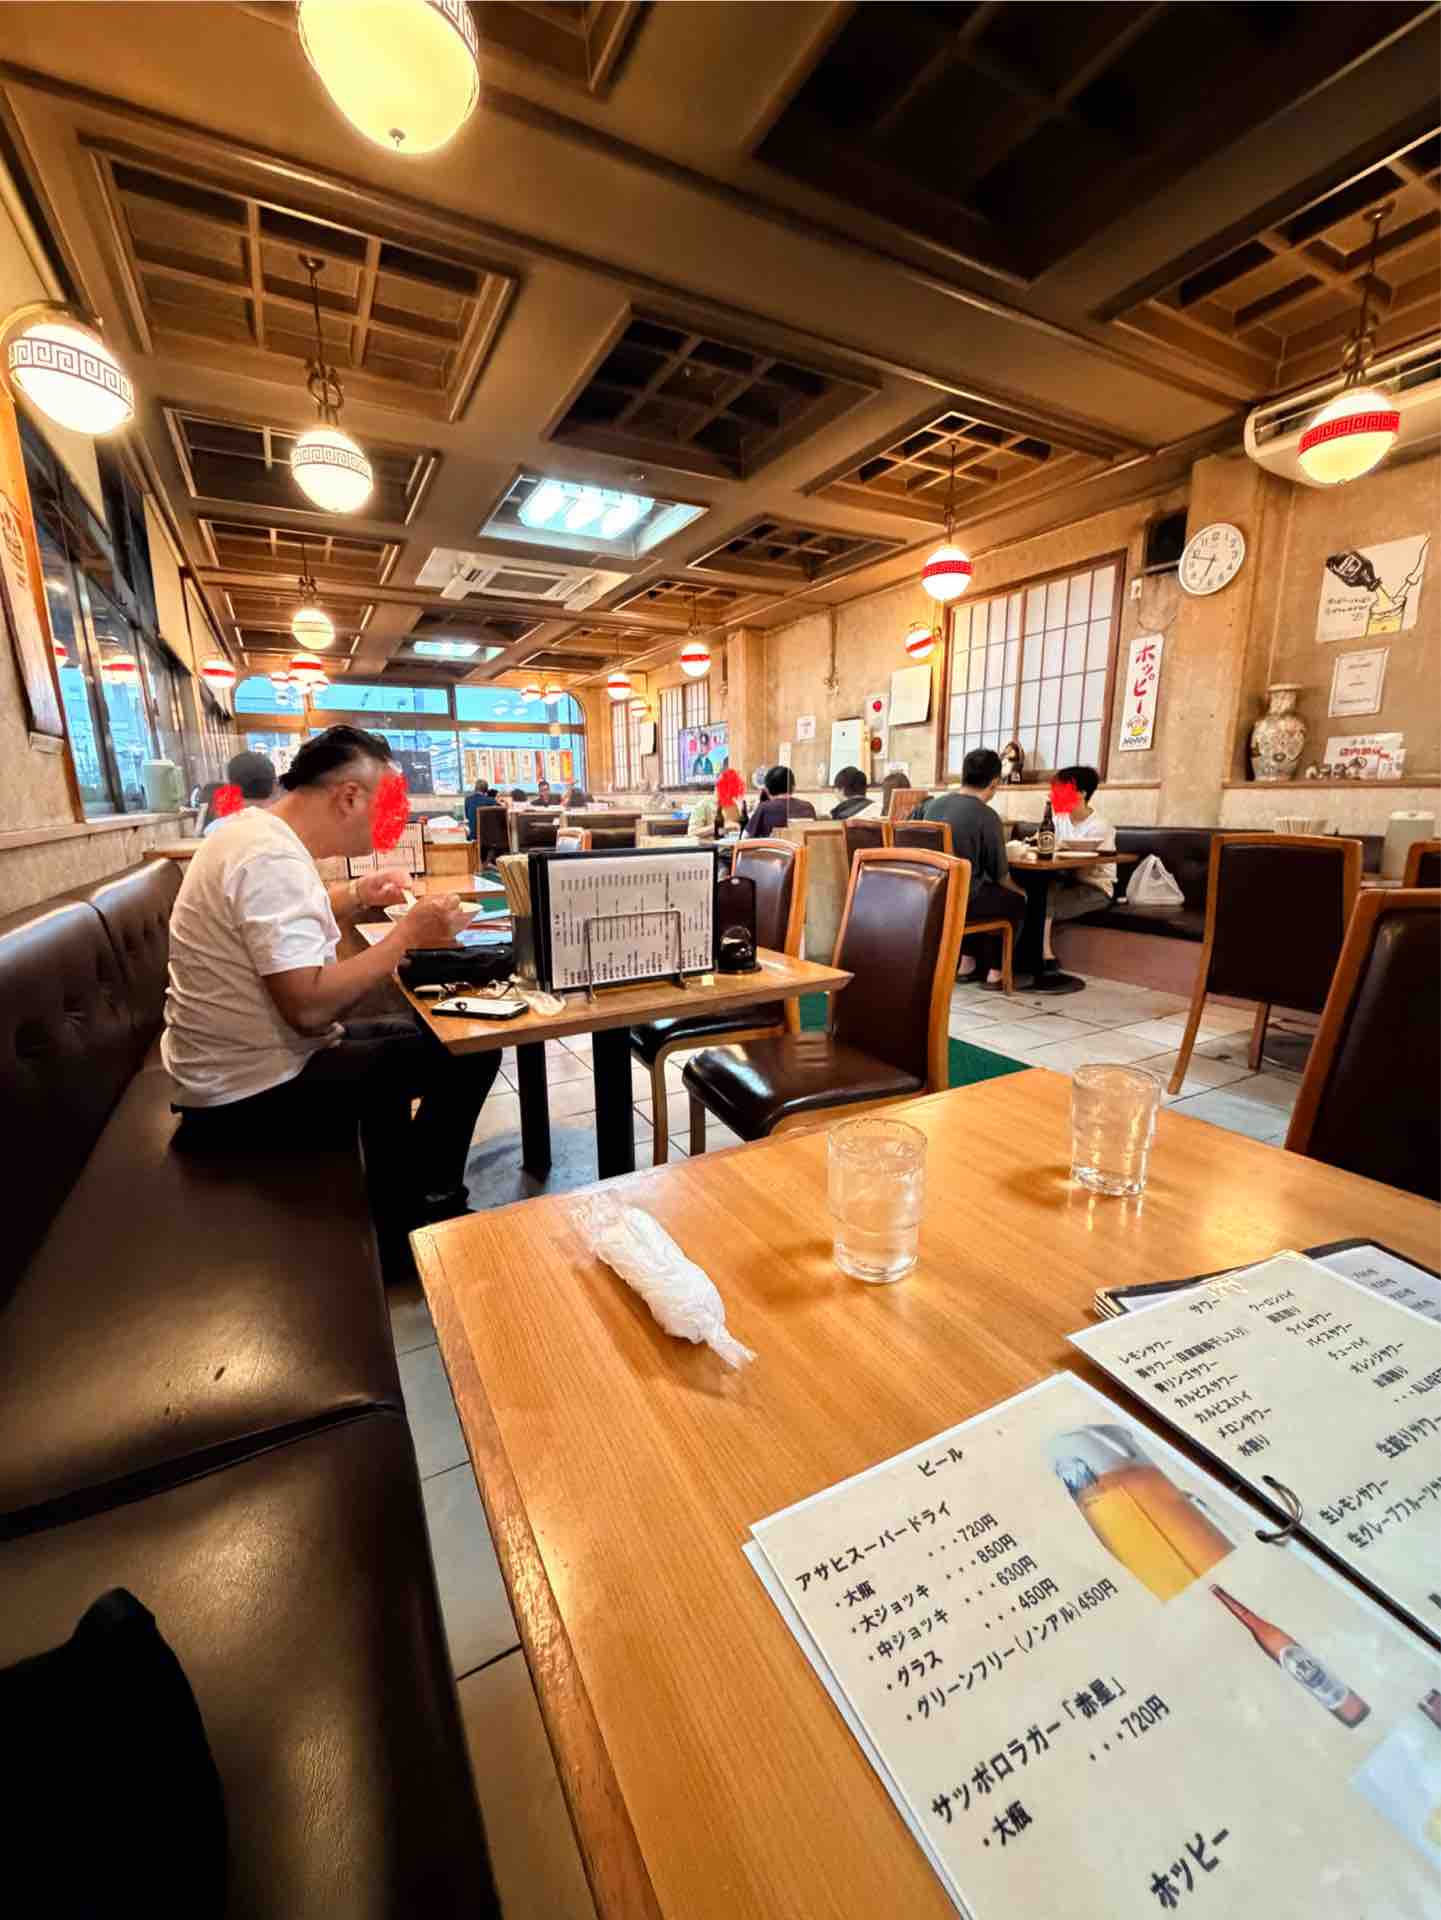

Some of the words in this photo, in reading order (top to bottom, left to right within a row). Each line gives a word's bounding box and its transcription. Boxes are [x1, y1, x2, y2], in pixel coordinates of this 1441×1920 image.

[1134, 644, 1155, 714] ホッピー
[1189, 1299, 1221, 1314] サワー
[1118, 1339, 1173, 1365] レモンサワー
[1217, 1407, 1272, 1440] メロンサワー
[918, 1447, 963, 1477] ビール
[1319, 1480, 1389, 1526] 生レモンサワー
[795, 1501, 951, 1592] アサヒスーパードライ
